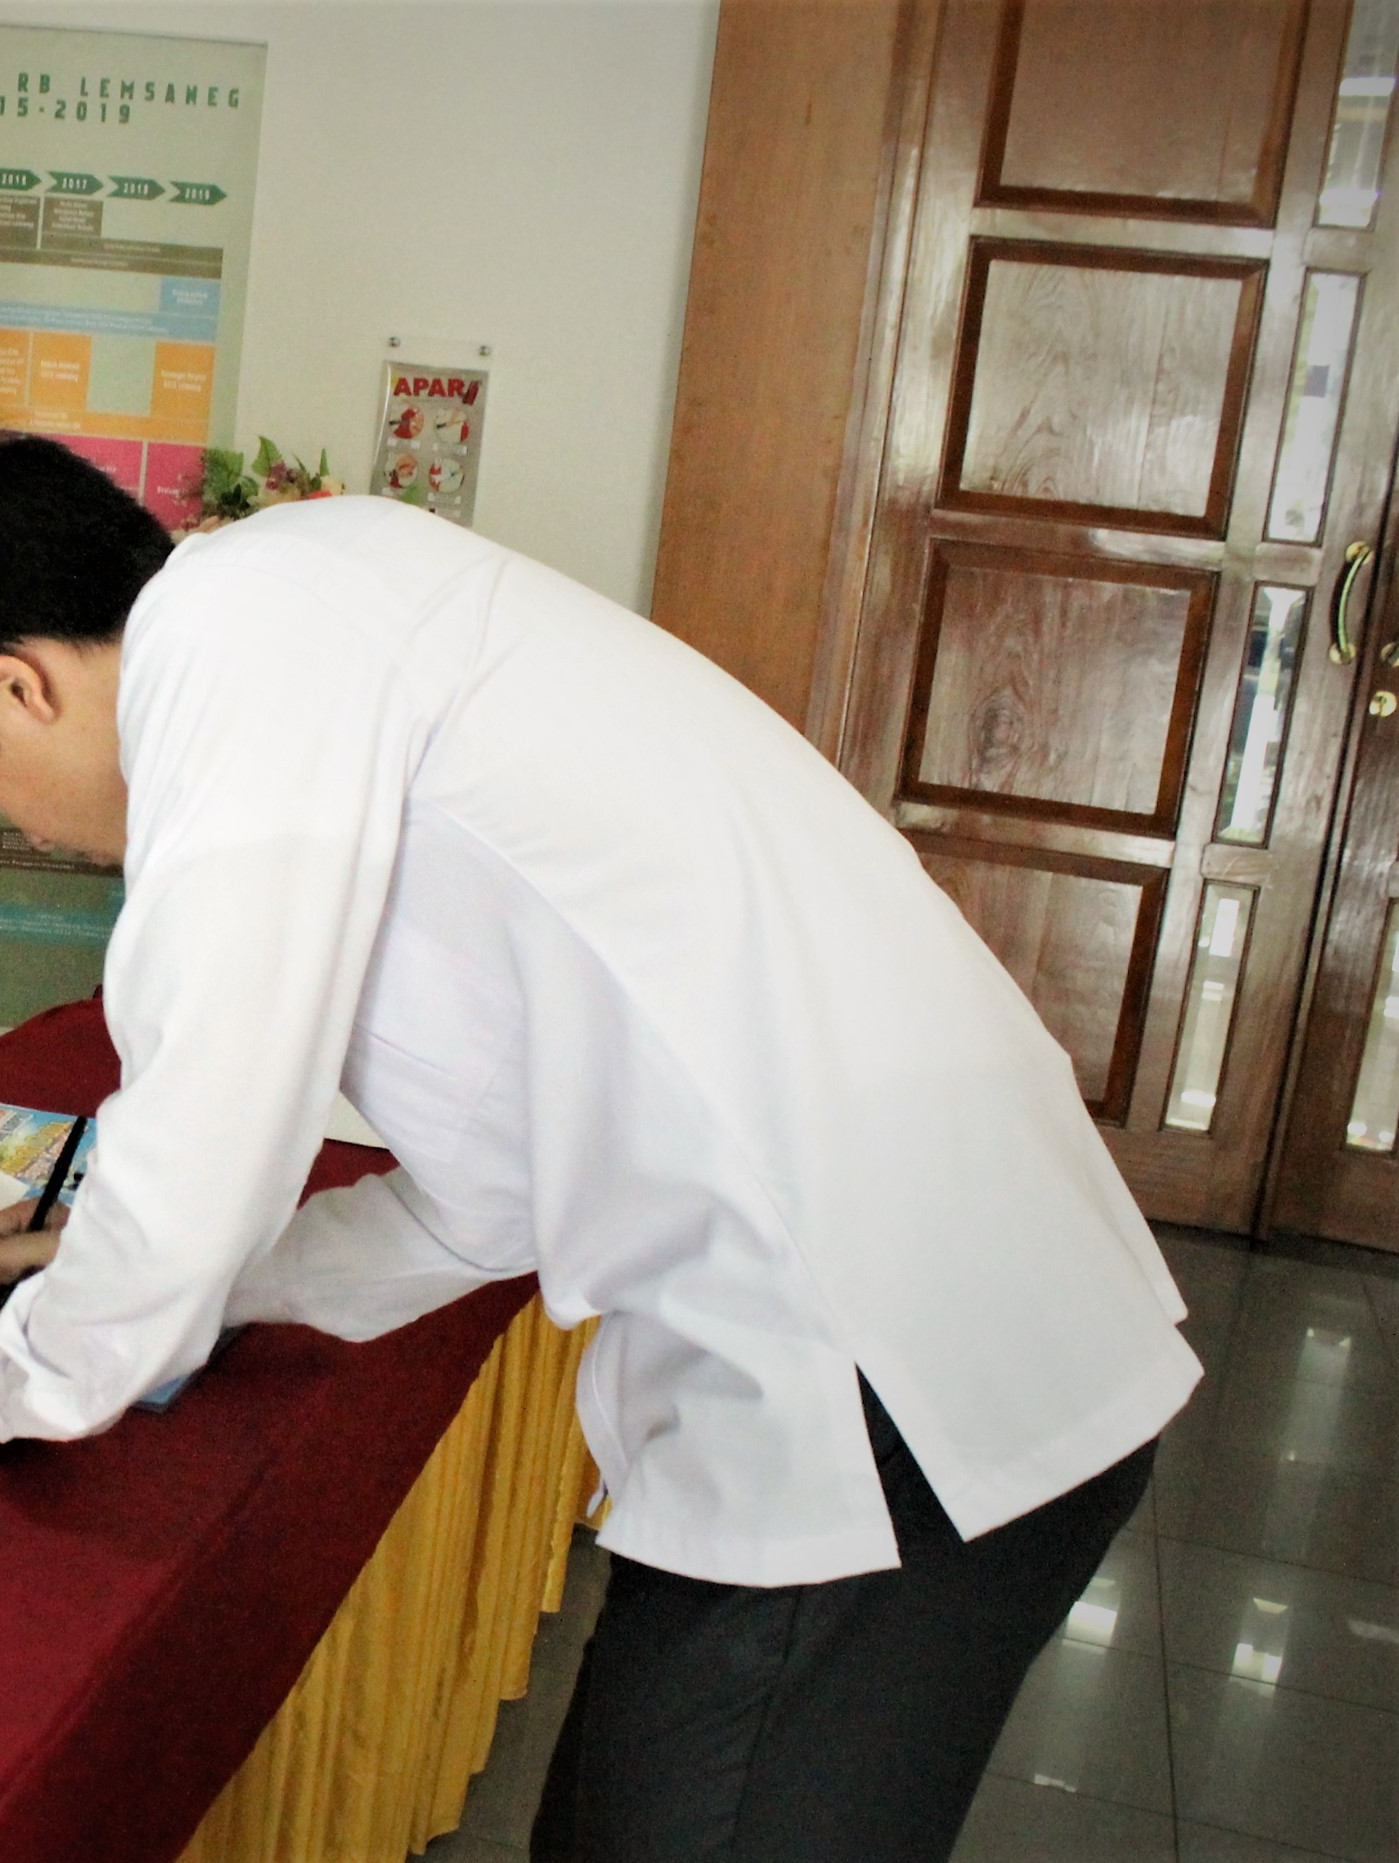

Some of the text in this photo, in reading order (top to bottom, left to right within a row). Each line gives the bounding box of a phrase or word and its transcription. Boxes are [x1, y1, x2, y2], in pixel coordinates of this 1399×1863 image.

[17, 72, 51, 94] RB
[79, 76, 240, 108] LEMSANEG
[62, 177, 88, 190] 2017
[393, 376, 466, 398] APAR
